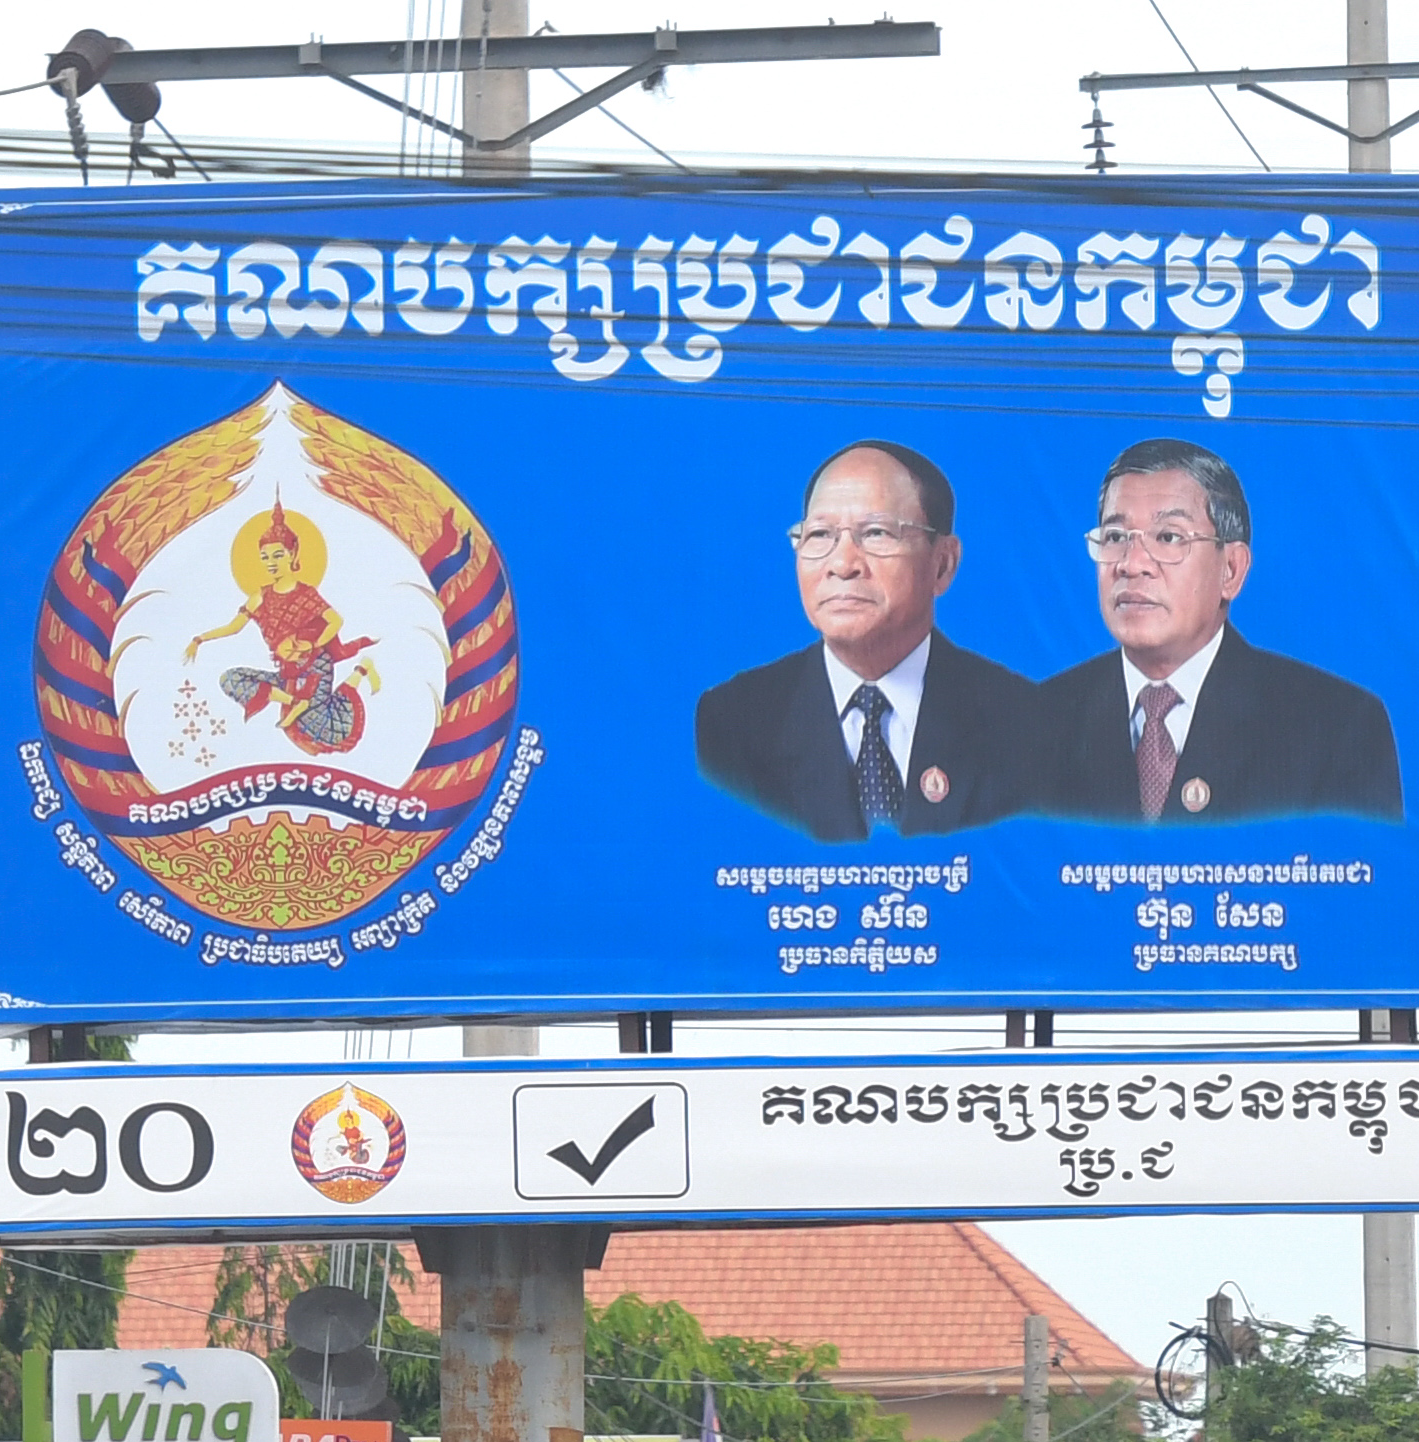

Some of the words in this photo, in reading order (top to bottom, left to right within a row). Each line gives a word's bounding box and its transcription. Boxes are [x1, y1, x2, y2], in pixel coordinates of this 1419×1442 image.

[135, 213, 1378, 417] គណបក្សប្រជាជនកម្ពុជា
[129, 768, 427, 826] គណបក្សប្រជាជនកម្ពុជា
[768, 904, 837, 930] ហេង
[1215, 891, 1284, 928] សែន
[1133, 943, 1299, 971] ប្រធានគណបក្ស
[5, 1090, 214, 1196] ២០
[1059, 1141, 1175, 1198] ប្រ.ជ
